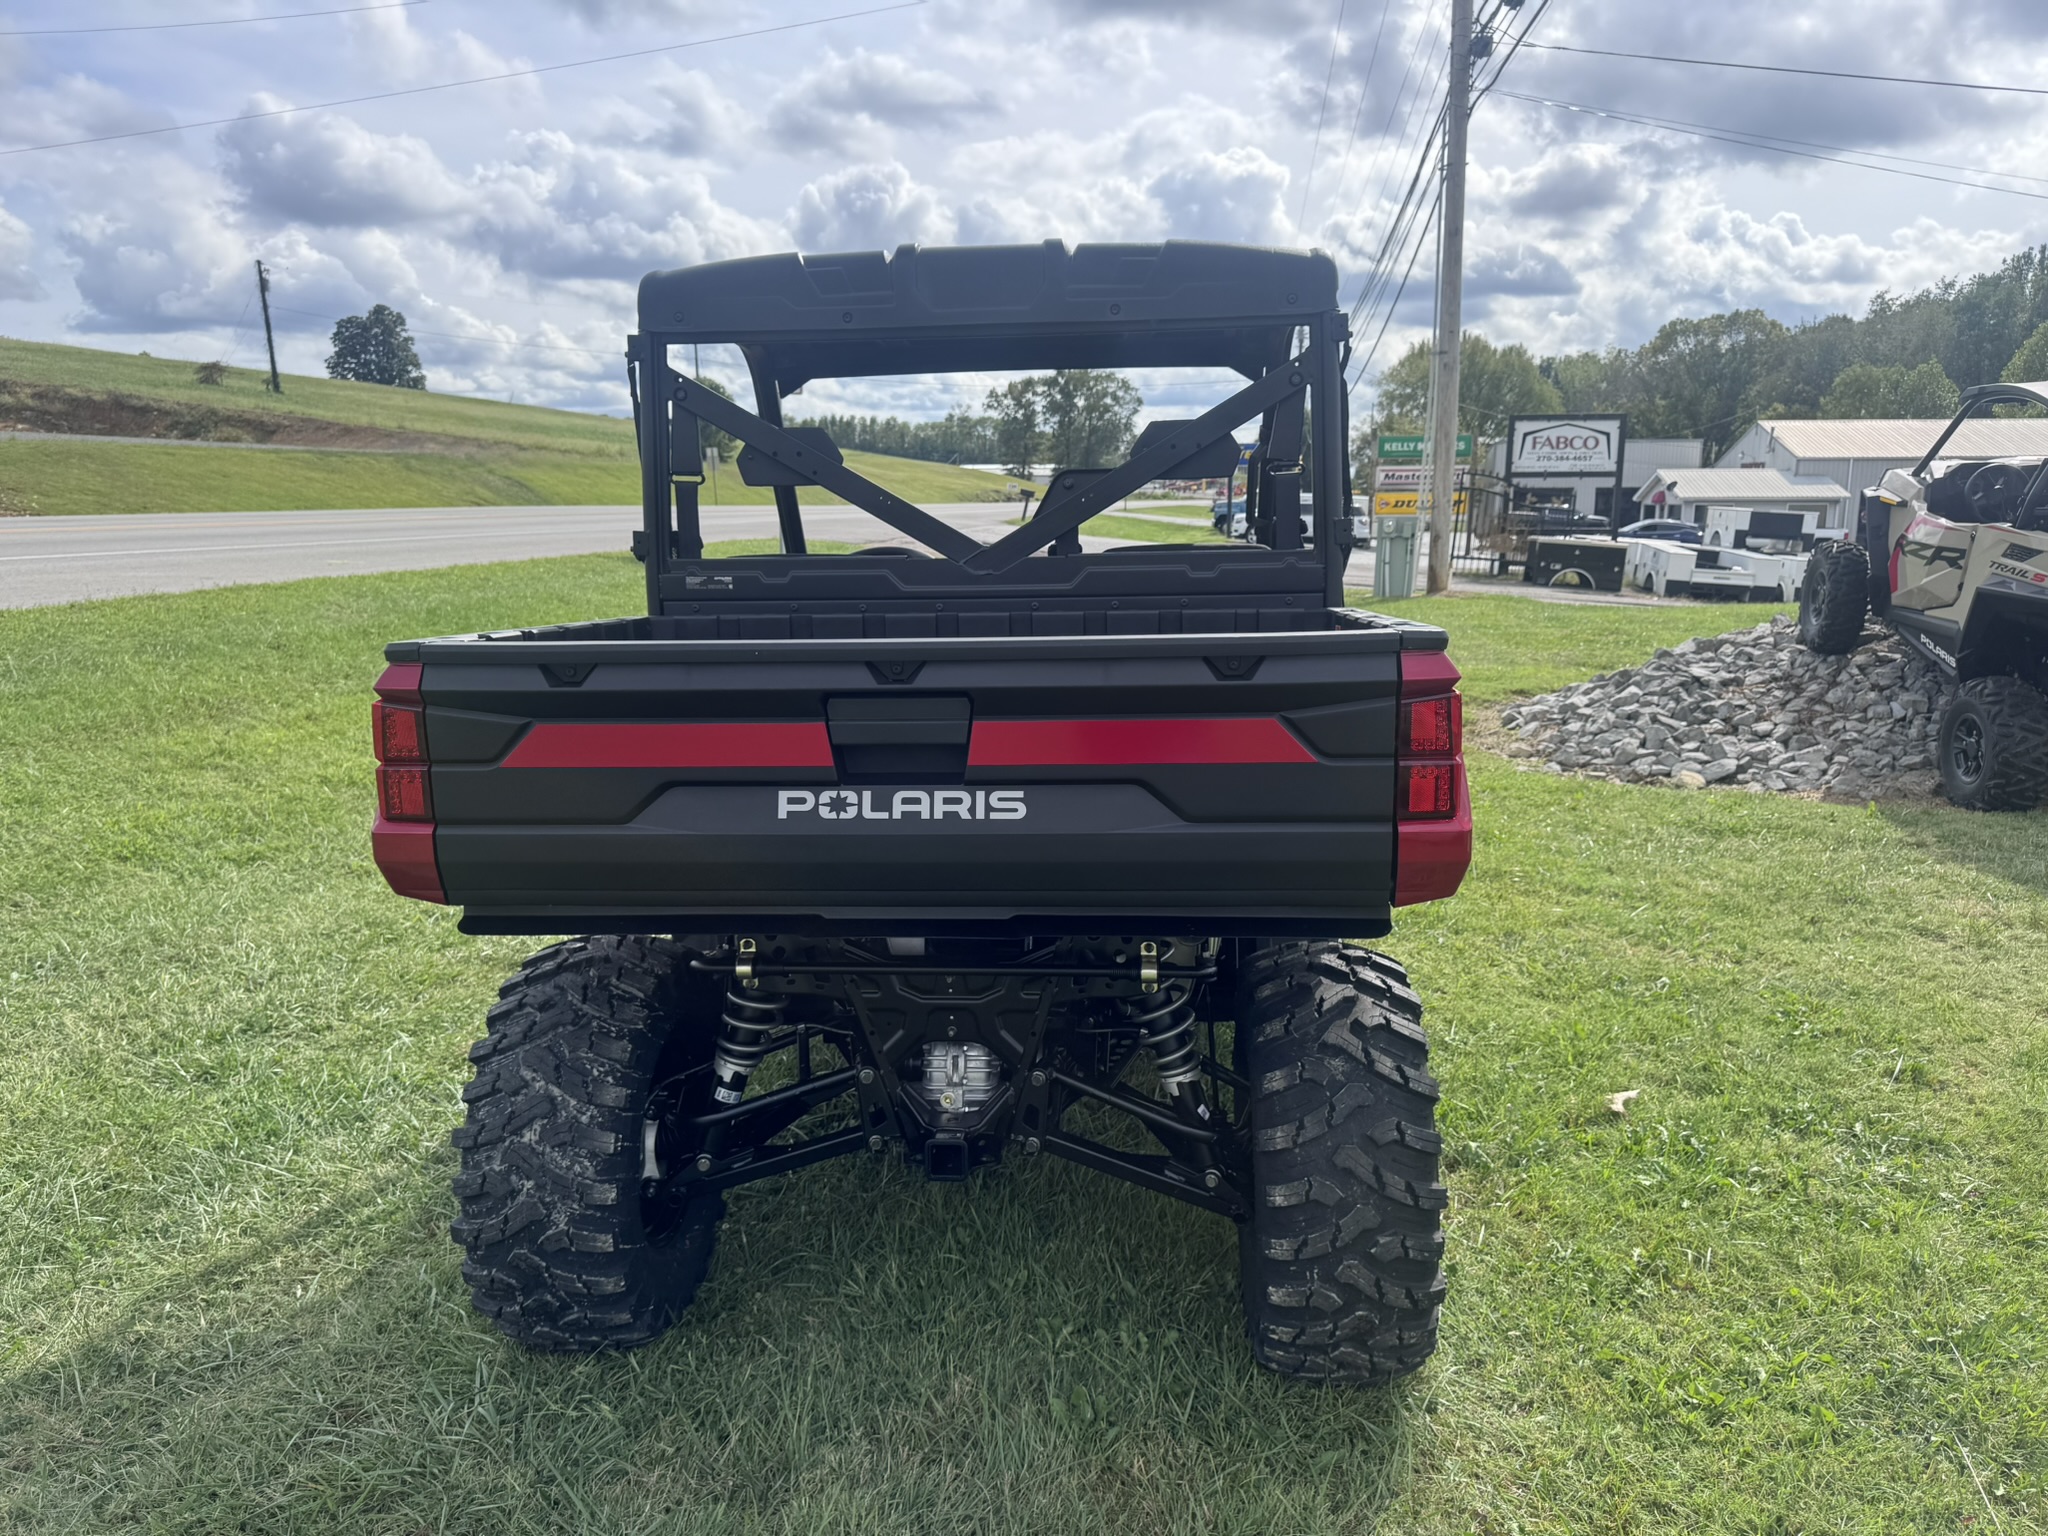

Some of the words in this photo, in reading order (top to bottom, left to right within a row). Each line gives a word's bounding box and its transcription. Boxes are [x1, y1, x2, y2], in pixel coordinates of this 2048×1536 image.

[1384, 442, 1415, 452] KELLY
[1531, 435, 1600, 451] FABCO
[1989, 560, 2029, 579] TRAIL
[2030, 573, 2048, 583] S
[1920, 633, 1957, 668] POLARIS
[778, 790, 1027, 819] POLARIS
